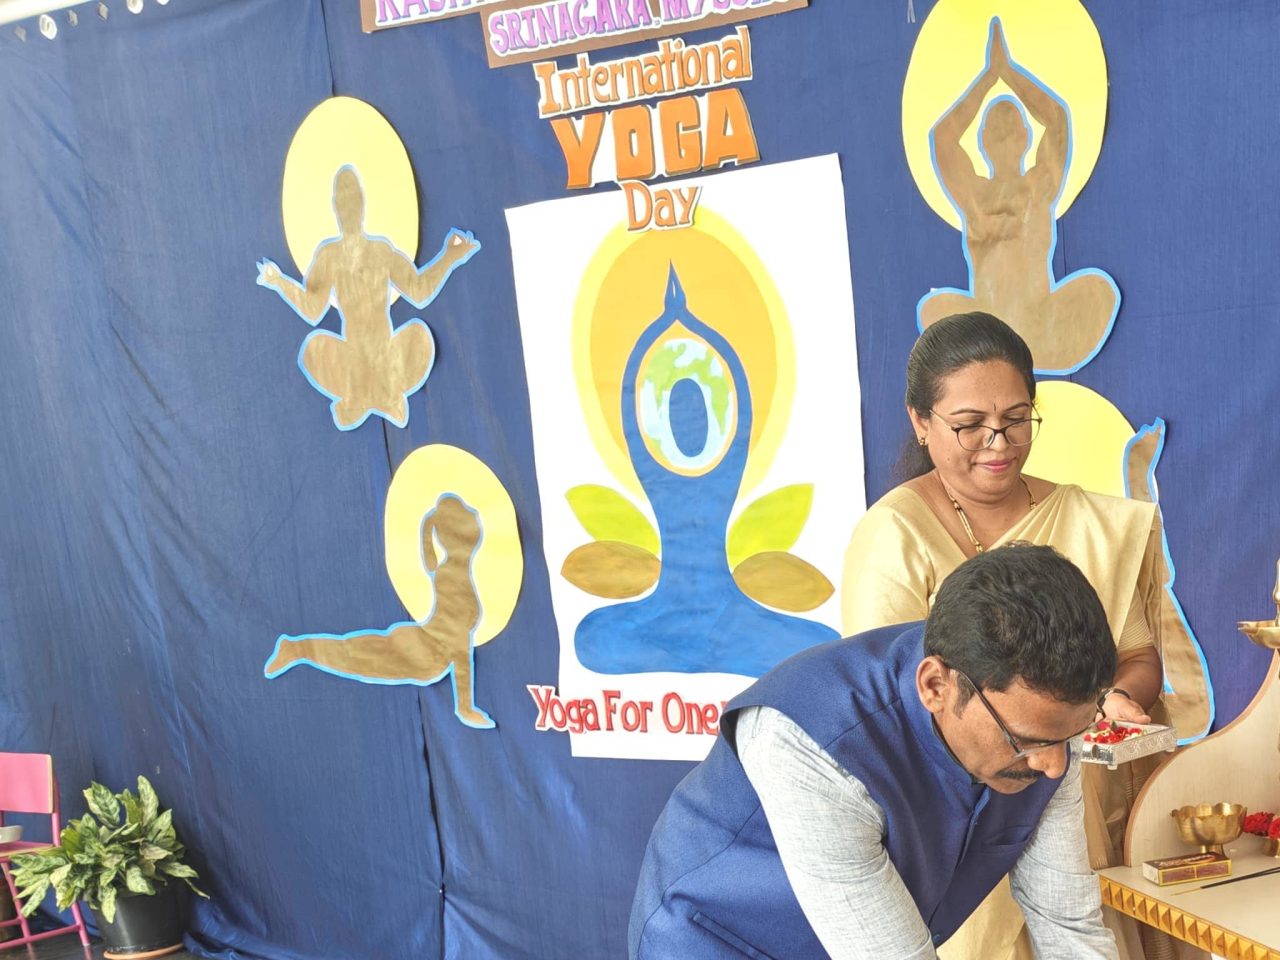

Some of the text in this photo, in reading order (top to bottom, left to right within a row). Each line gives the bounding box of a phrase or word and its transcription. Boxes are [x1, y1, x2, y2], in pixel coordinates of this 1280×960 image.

[538, 30, 751, 114] International
[549, 88, 761, 189] YOGA
[622, 183, 702, 231] Day
[530, 688, 601, 734] Yoga
[602, 690, 653, 733] For
